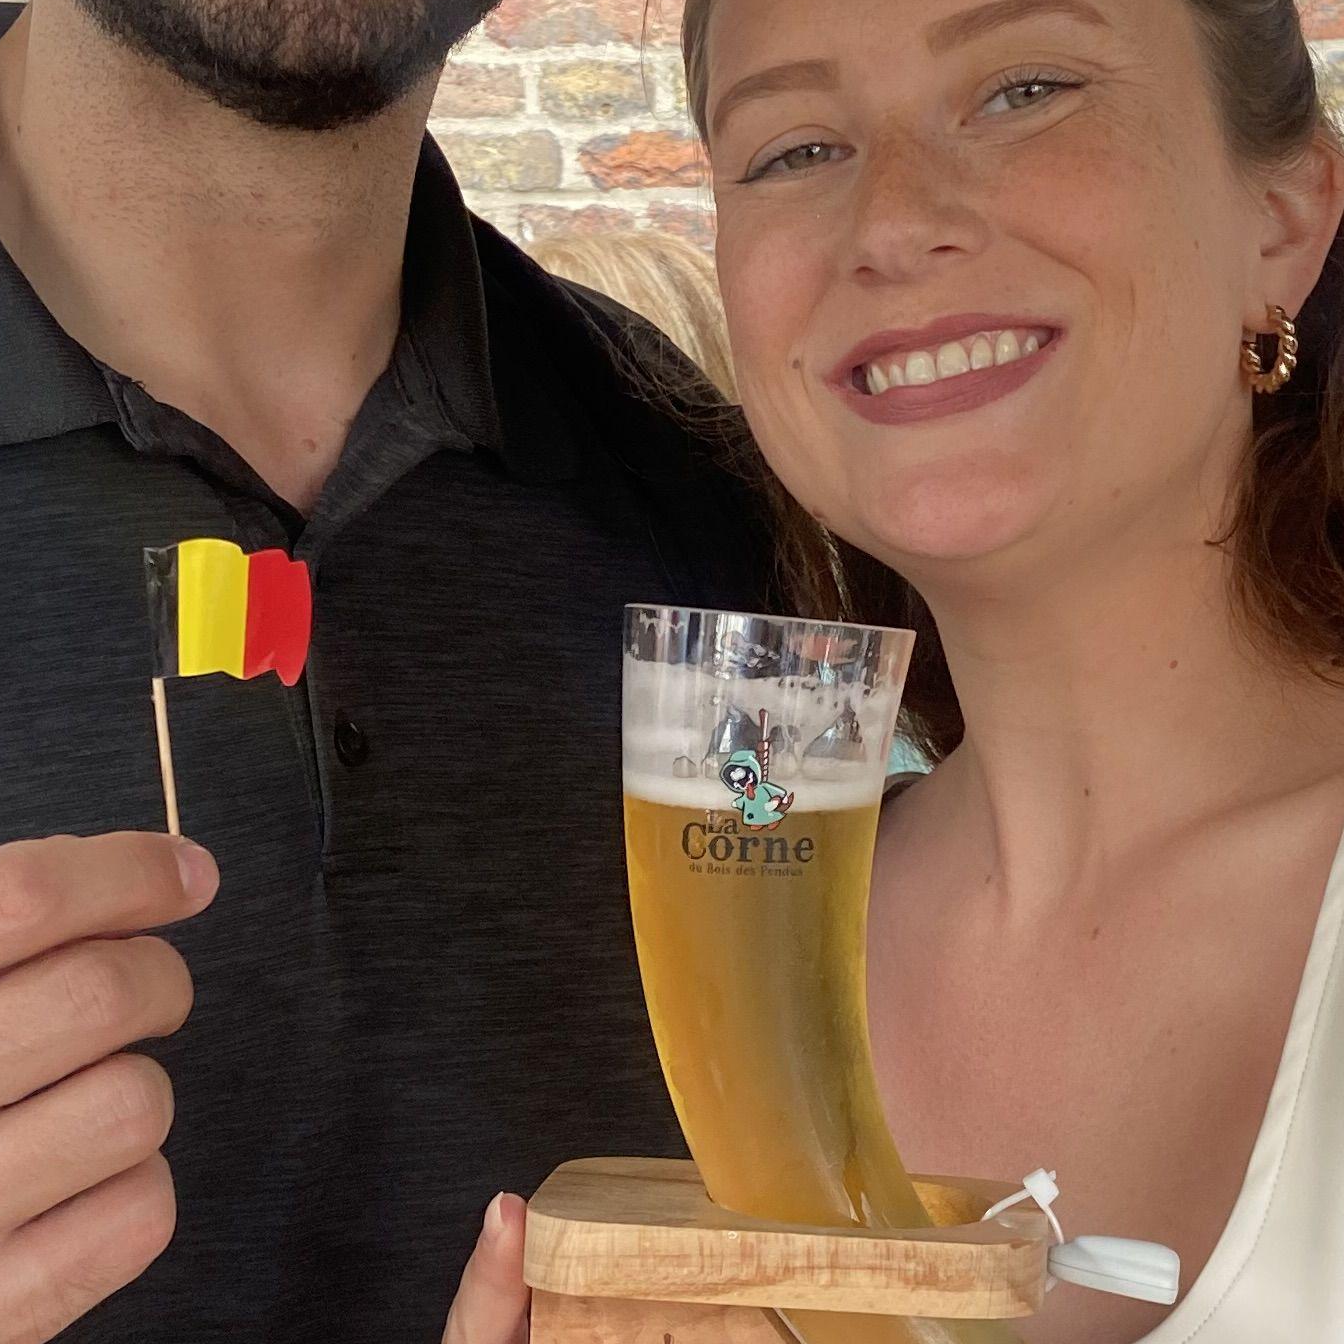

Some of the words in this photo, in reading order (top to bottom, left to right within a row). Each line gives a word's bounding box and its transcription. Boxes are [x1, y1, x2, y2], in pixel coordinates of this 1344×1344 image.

[681, 822, 815, 864] Corne
[688, 862, 703, 874] du
[706, 863, 731, 875] Bois
[735, 864, 756, 876] des
